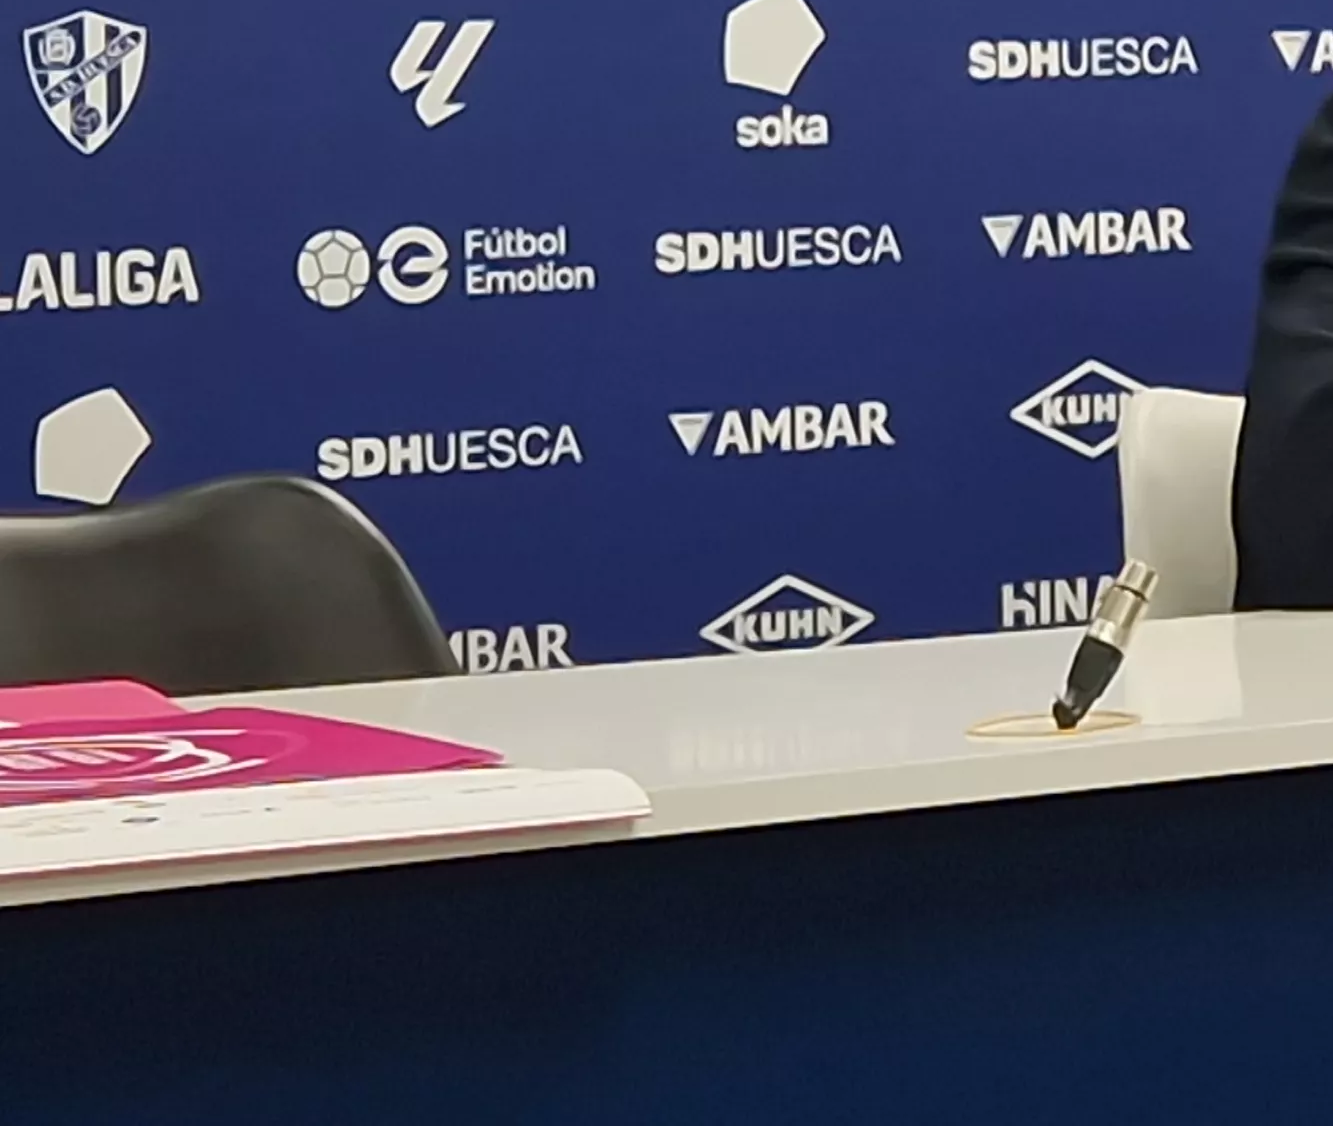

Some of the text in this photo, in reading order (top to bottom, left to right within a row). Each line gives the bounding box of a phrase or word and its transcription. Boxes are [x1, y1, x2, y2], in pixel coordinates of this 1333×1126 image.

[736, 104, 829, 148] soka
[464, 225, 566, 260] Fútbol
[1022, 207, 1192, 258] AMBAR
[465, 260, 595, 295] Emotion
[713, 401, 895, 456] AMBAR
[1041, 391, 1118, 428] KUH
[735, 604, 843, 642] KUHN
[448, 622, 578, 674] BAR
